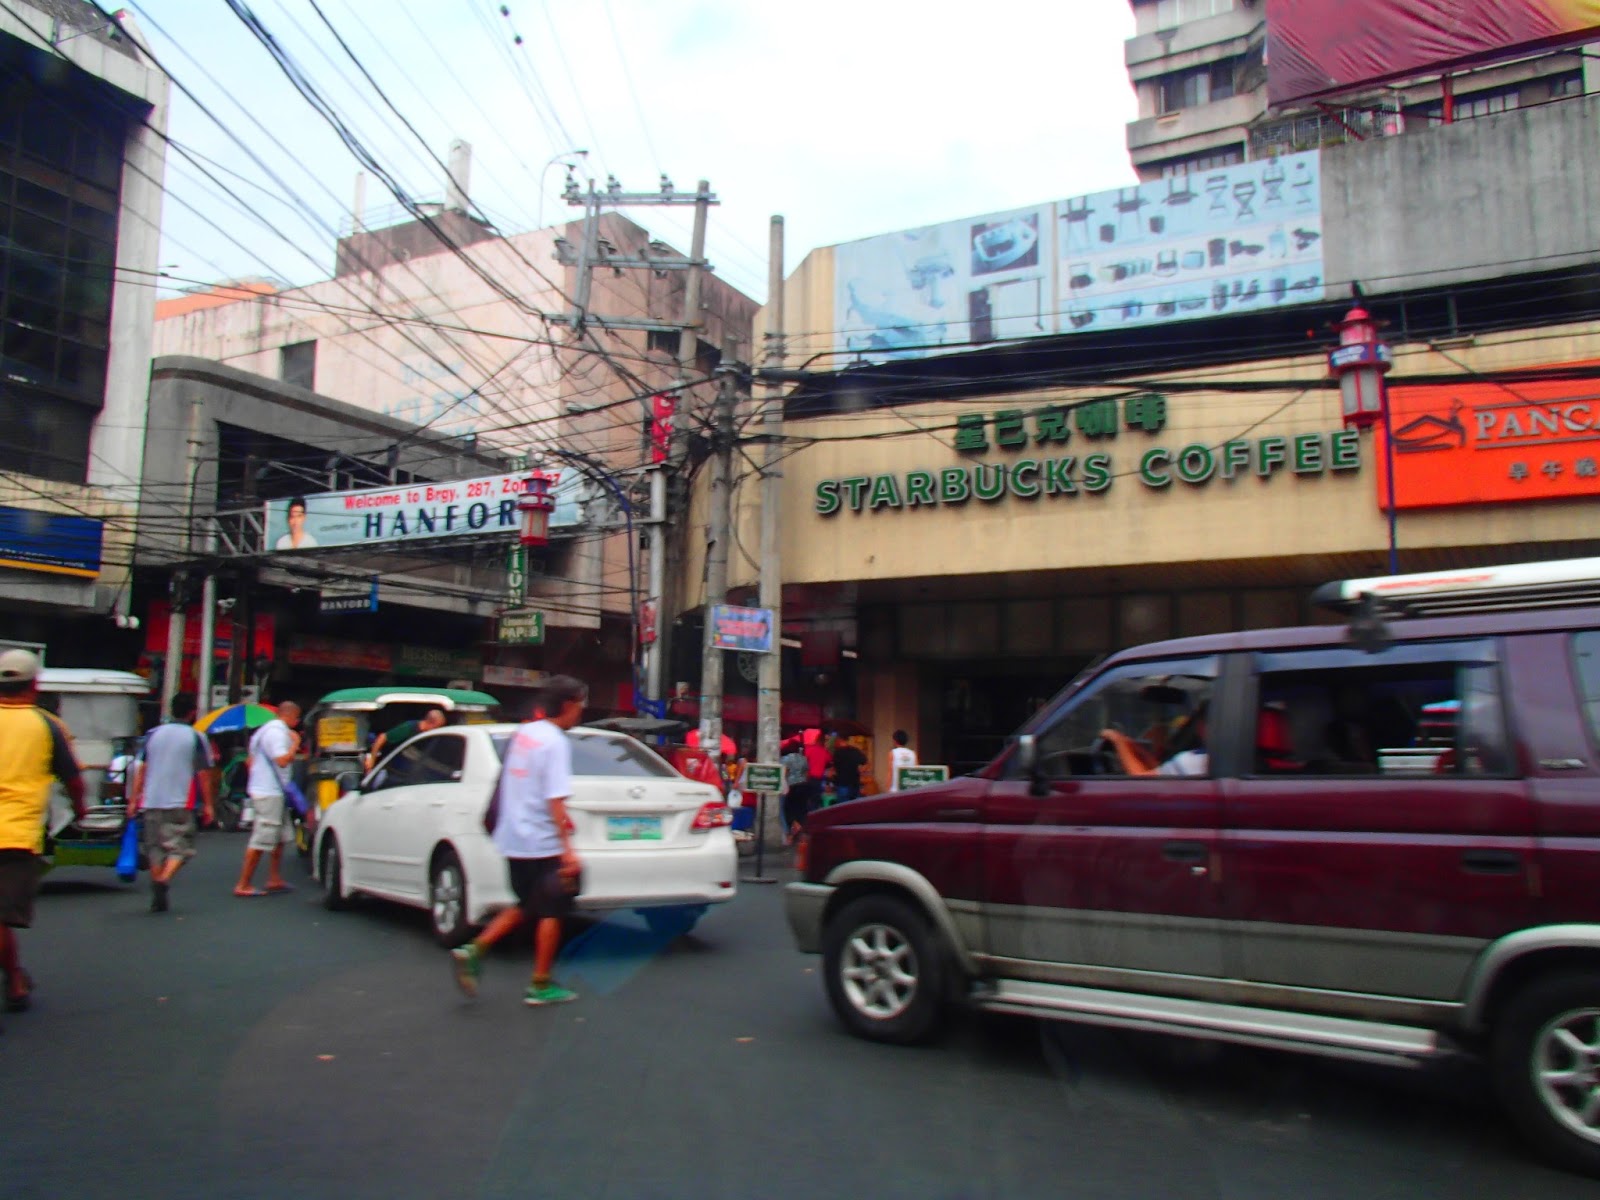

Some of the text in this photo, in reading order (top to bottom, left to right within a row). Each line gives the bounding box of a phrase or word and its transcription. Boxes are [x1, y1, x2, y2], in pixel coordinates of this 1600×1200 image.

[953, 393, 1167, 451] 星巴克咖啡
[1474, 404, 1600, 440] PANC
[815, 428, 1361, 515] STARBUCKS COFFEE
[344, 494, 401, 510] Welcome
[406, 491, 419, 503] to
[426, 487, 459, 504] Brgy.
[468, 481, 495, 497] 287,
[502, 478, 529, 494] Zon
[365, 499, 520, 538] HANFOR
